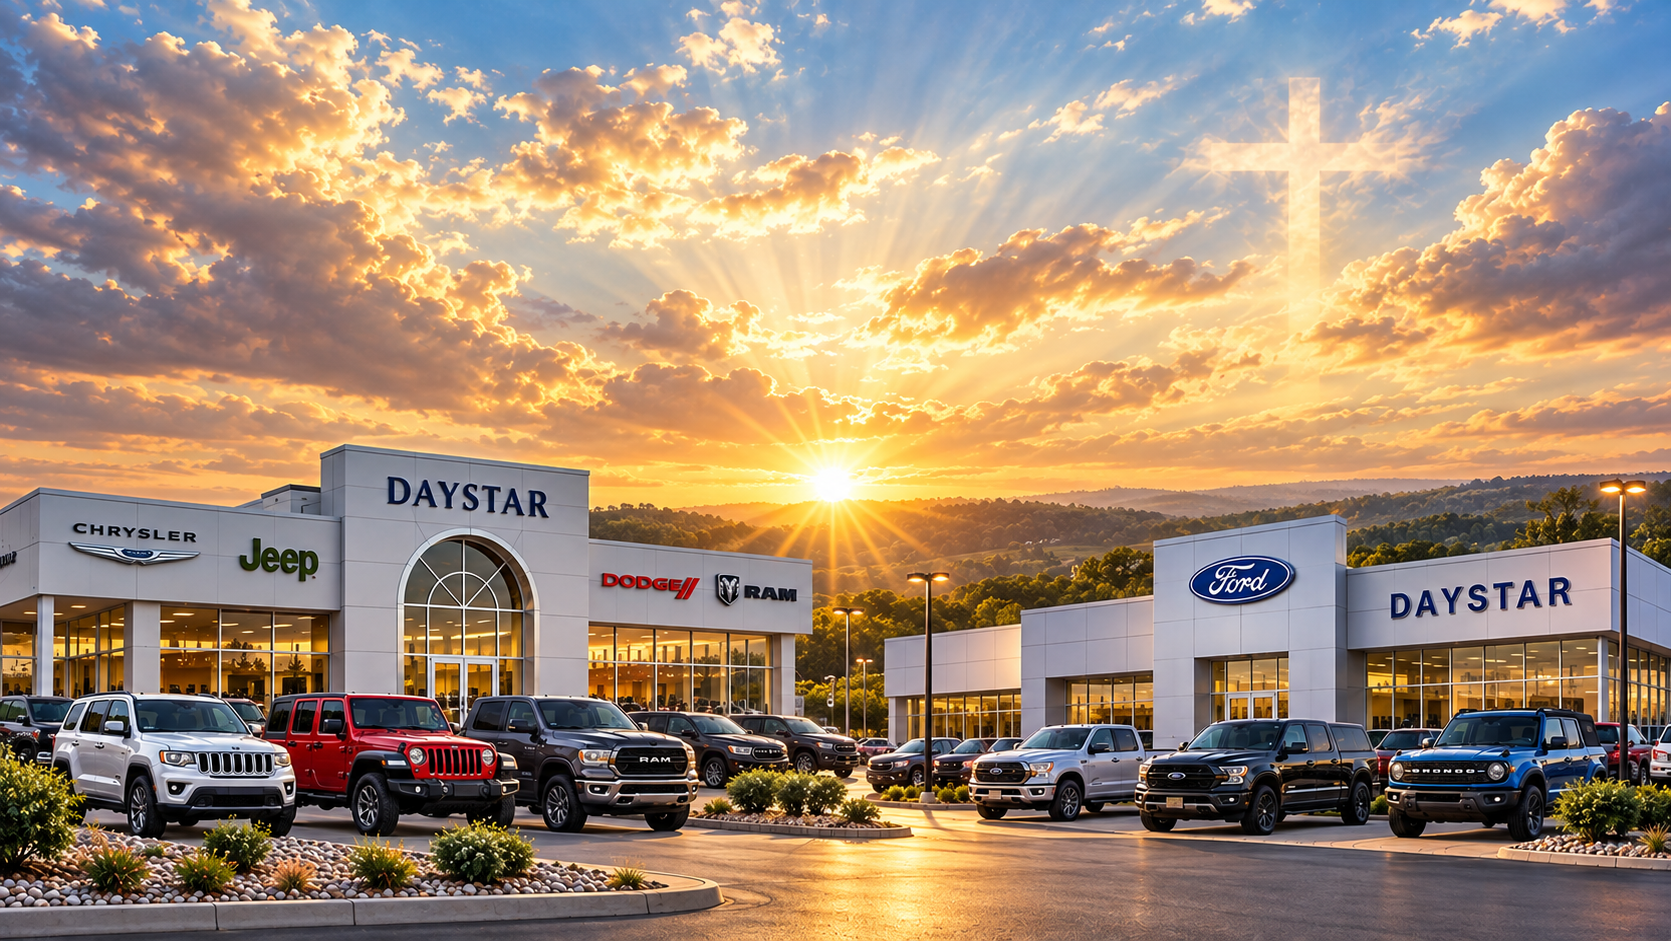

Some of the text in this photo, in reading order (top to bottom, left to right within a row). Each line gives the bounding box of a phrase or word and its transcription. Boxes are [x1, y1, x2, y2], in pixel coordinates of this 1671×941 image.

[387, 476, 549, 518] DAYSTAR
[73, 522, 197, 543] CHRYSLER
[239, 537, 319, 582] Jeep
[602, 572, 685, 592] DODGE
[744, 584, 797, 602] RAM
[1208, 563, 1269, 595] Ford
[1390, 577, 1572, 619] DAYSTAR
